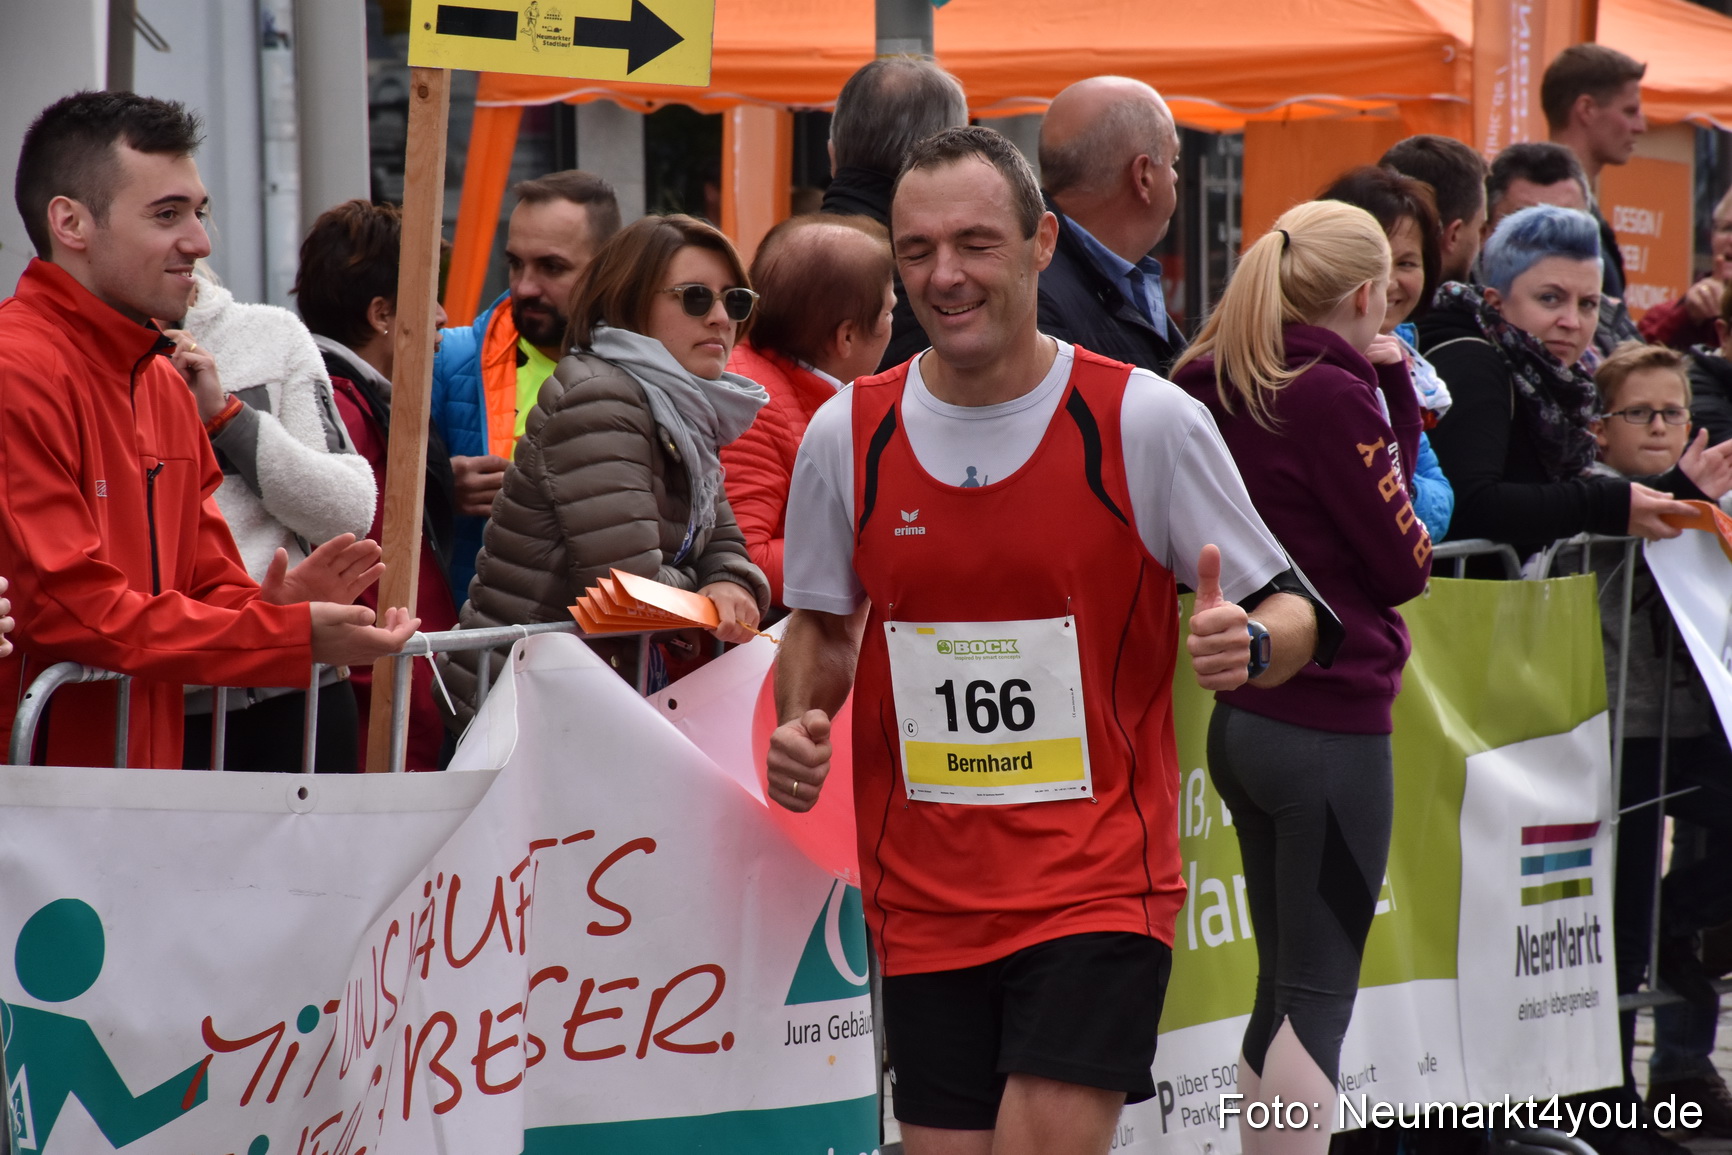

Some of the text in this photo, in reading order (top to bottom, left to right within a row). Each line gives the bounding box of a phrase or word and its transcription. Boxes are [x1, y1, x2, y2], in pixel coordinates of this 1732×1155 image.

[536, 33, 571, 42] Neumarkter
[542, 40, 571, 48] Stadtlauf
[894, 525, 926, 537] erima
[953, 639, 1020, 655] BOCK
[935, 678, 1036, 734] 166
[947, 751, 1033, 773] Bernhard
[784, 1020, 821, 1046] Jura
[1176, 1074, 1209, 1097] über
[1157, 1080, 1175, 1134] P
